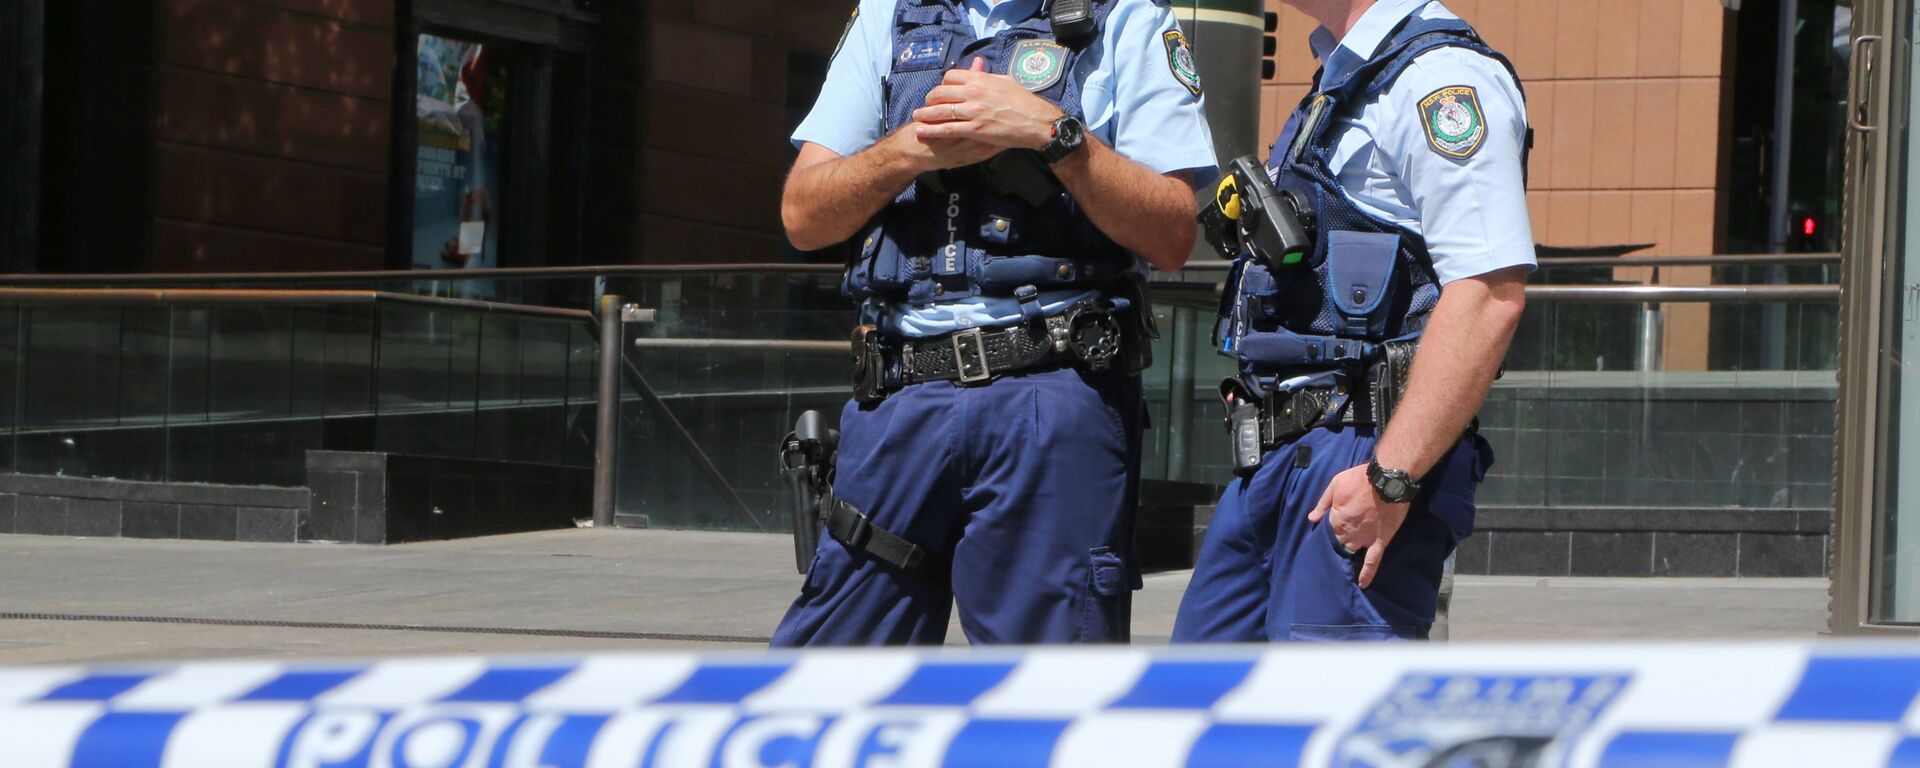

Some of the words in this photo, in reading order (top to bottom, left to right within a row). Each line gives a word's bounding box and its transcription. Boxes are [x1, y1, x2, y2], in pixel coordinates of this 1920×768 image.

[1443, 89, 1471, 97] POLICE
[944, 192, 960, 272] POLICE
[293, 709, 932, 768] POLICE
